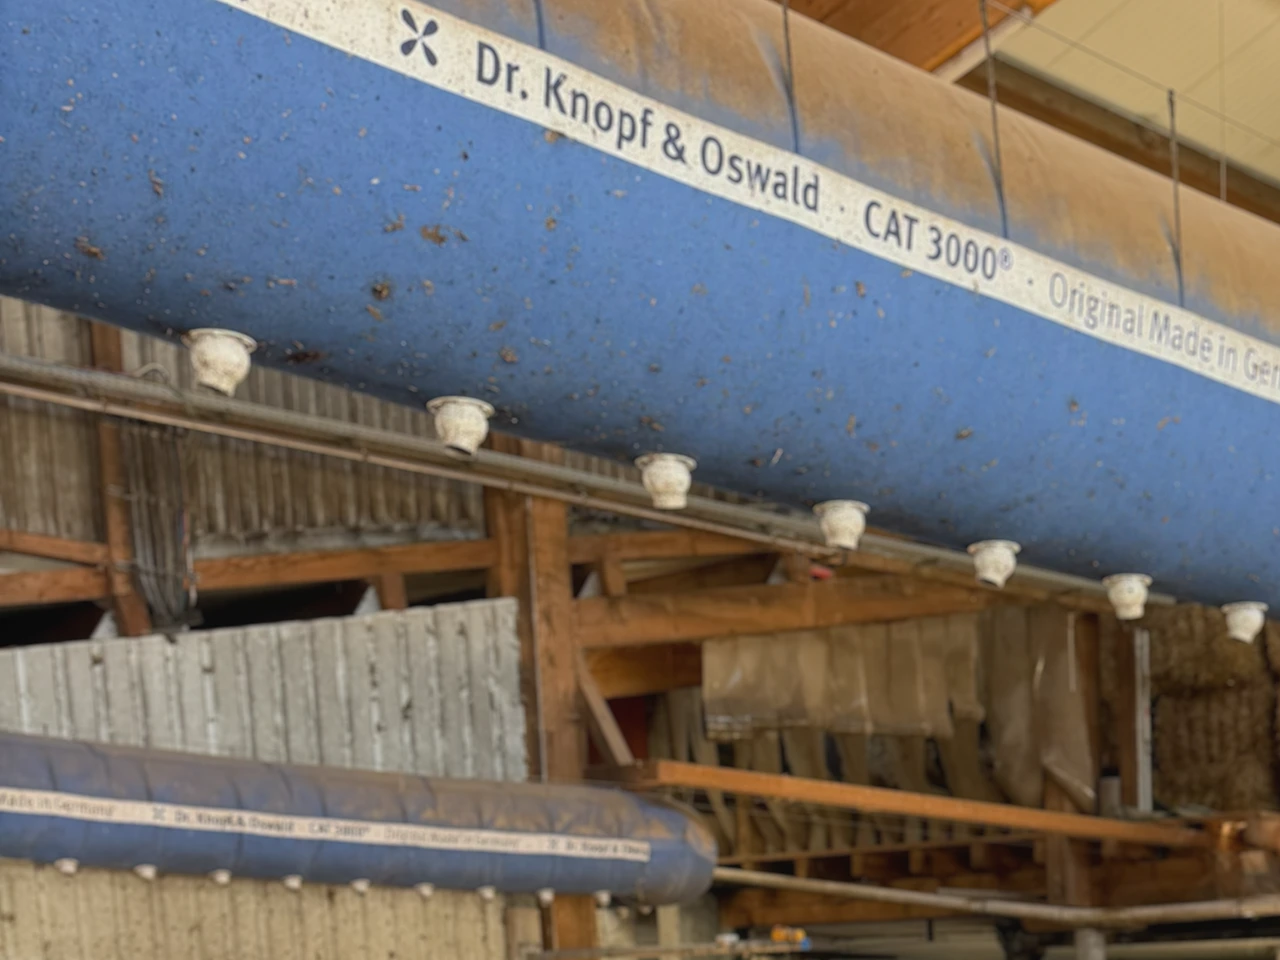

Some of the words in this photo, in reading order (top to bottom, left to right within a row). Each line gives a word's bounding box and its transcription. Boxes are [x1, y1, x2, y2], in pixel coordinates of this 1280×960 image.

[476, 40, 529, 101] Dr.
[544, 67, 654, 150] Knopf
[662, 121, 688, 165] &
[701, 135, 820, 213] Oswald
[864, 200, 919, 252] CAT
[1049, 271, 1145, 339] Original
[1148, 309, 1214, 363] Made
[1217, 335, 1239, 373] in
